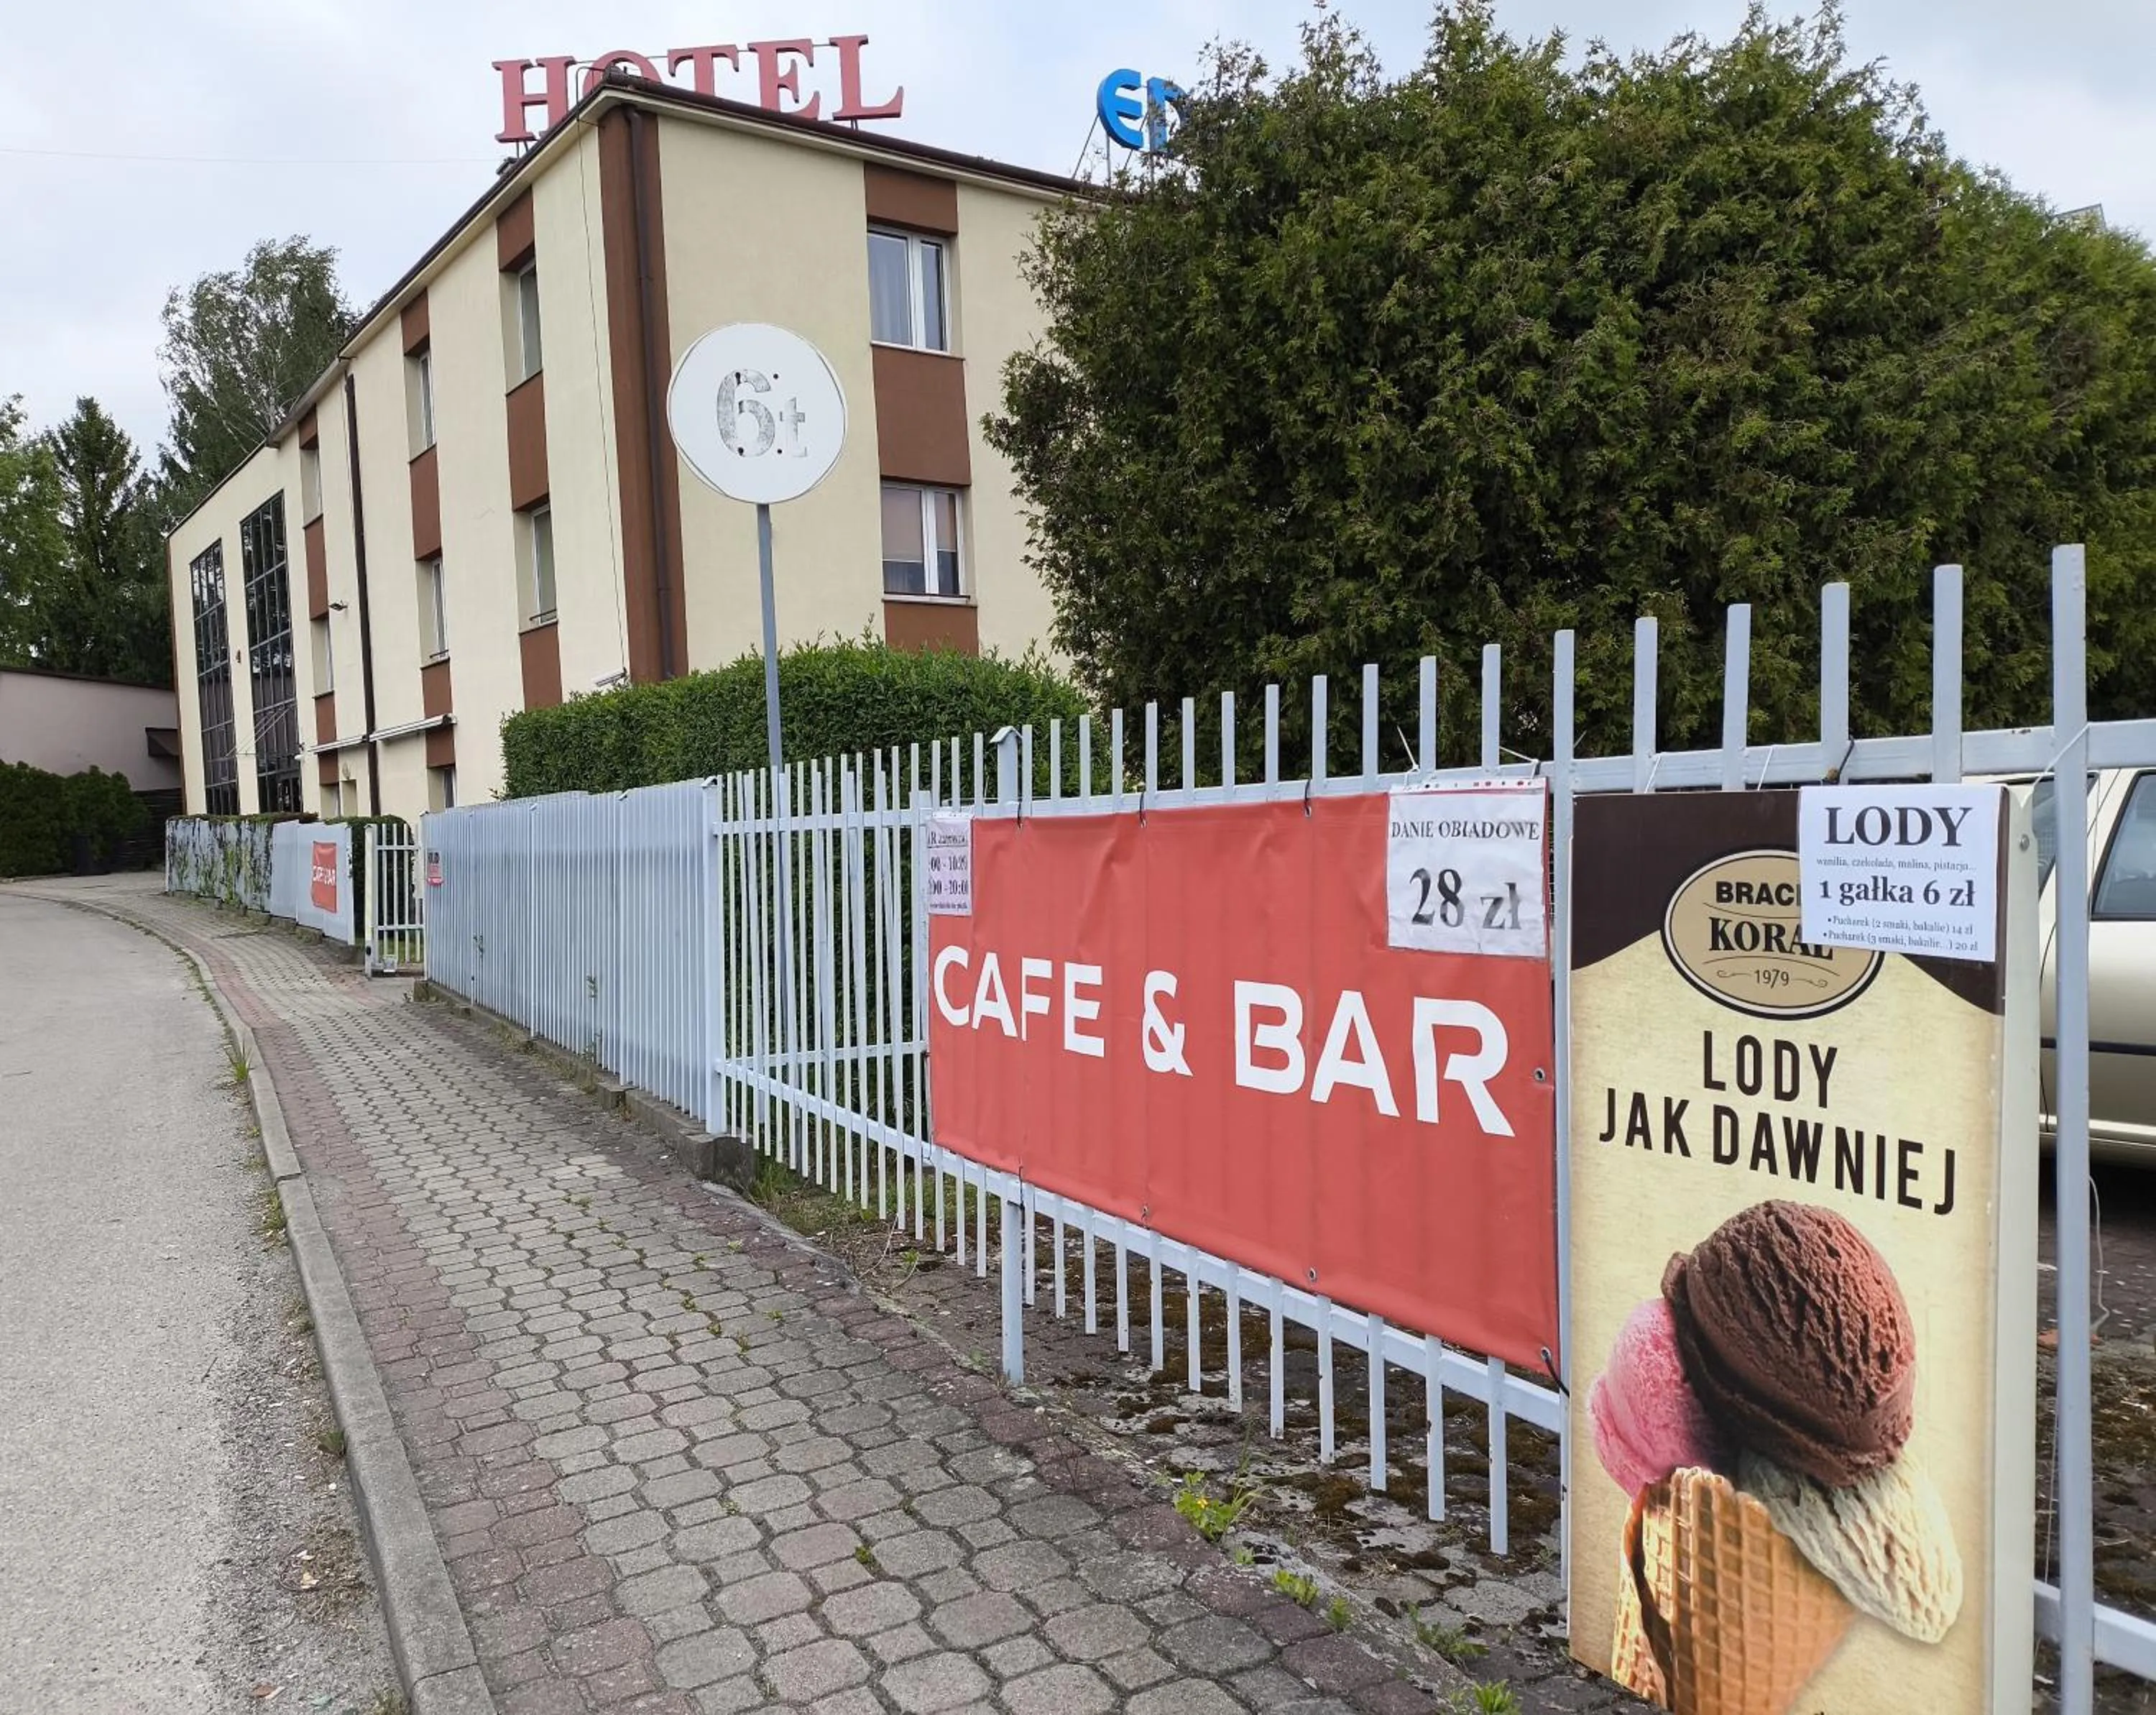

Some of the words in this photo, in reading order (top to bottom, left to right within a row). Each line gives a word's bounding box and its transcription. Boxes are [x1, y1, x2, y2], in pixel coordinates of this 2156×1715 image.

[492, 34, 904, 142] HOTEL
[1391, 820, 1434, 838] DANIE
[1438, 821, 1540, 840] OBIADOWE
[1824, 806, 1973, 847] LODY
[1410, 868, 1465, 927] 28
[1480, 883, 1521, 929] zł
[1820, 881, 1831, 899] 1
[1839, 875, 1915, 906] gałka
[1922, 880, 1941, 905] 6
[1949, 880, 1976, 906] zł
[1754, 968, 1790, 989] 1979
[934, 945, 1105, 1057] CAFE
[1143, 970, 1194, 1077] &
[1234, 980, 1516, 1136] BAR
[1703, 1030, 1838, 1109] LODY
[1598, 1088, 1692, 1158] JAK
[1713, 1103, 1955, 1216] DAWNIEJ
